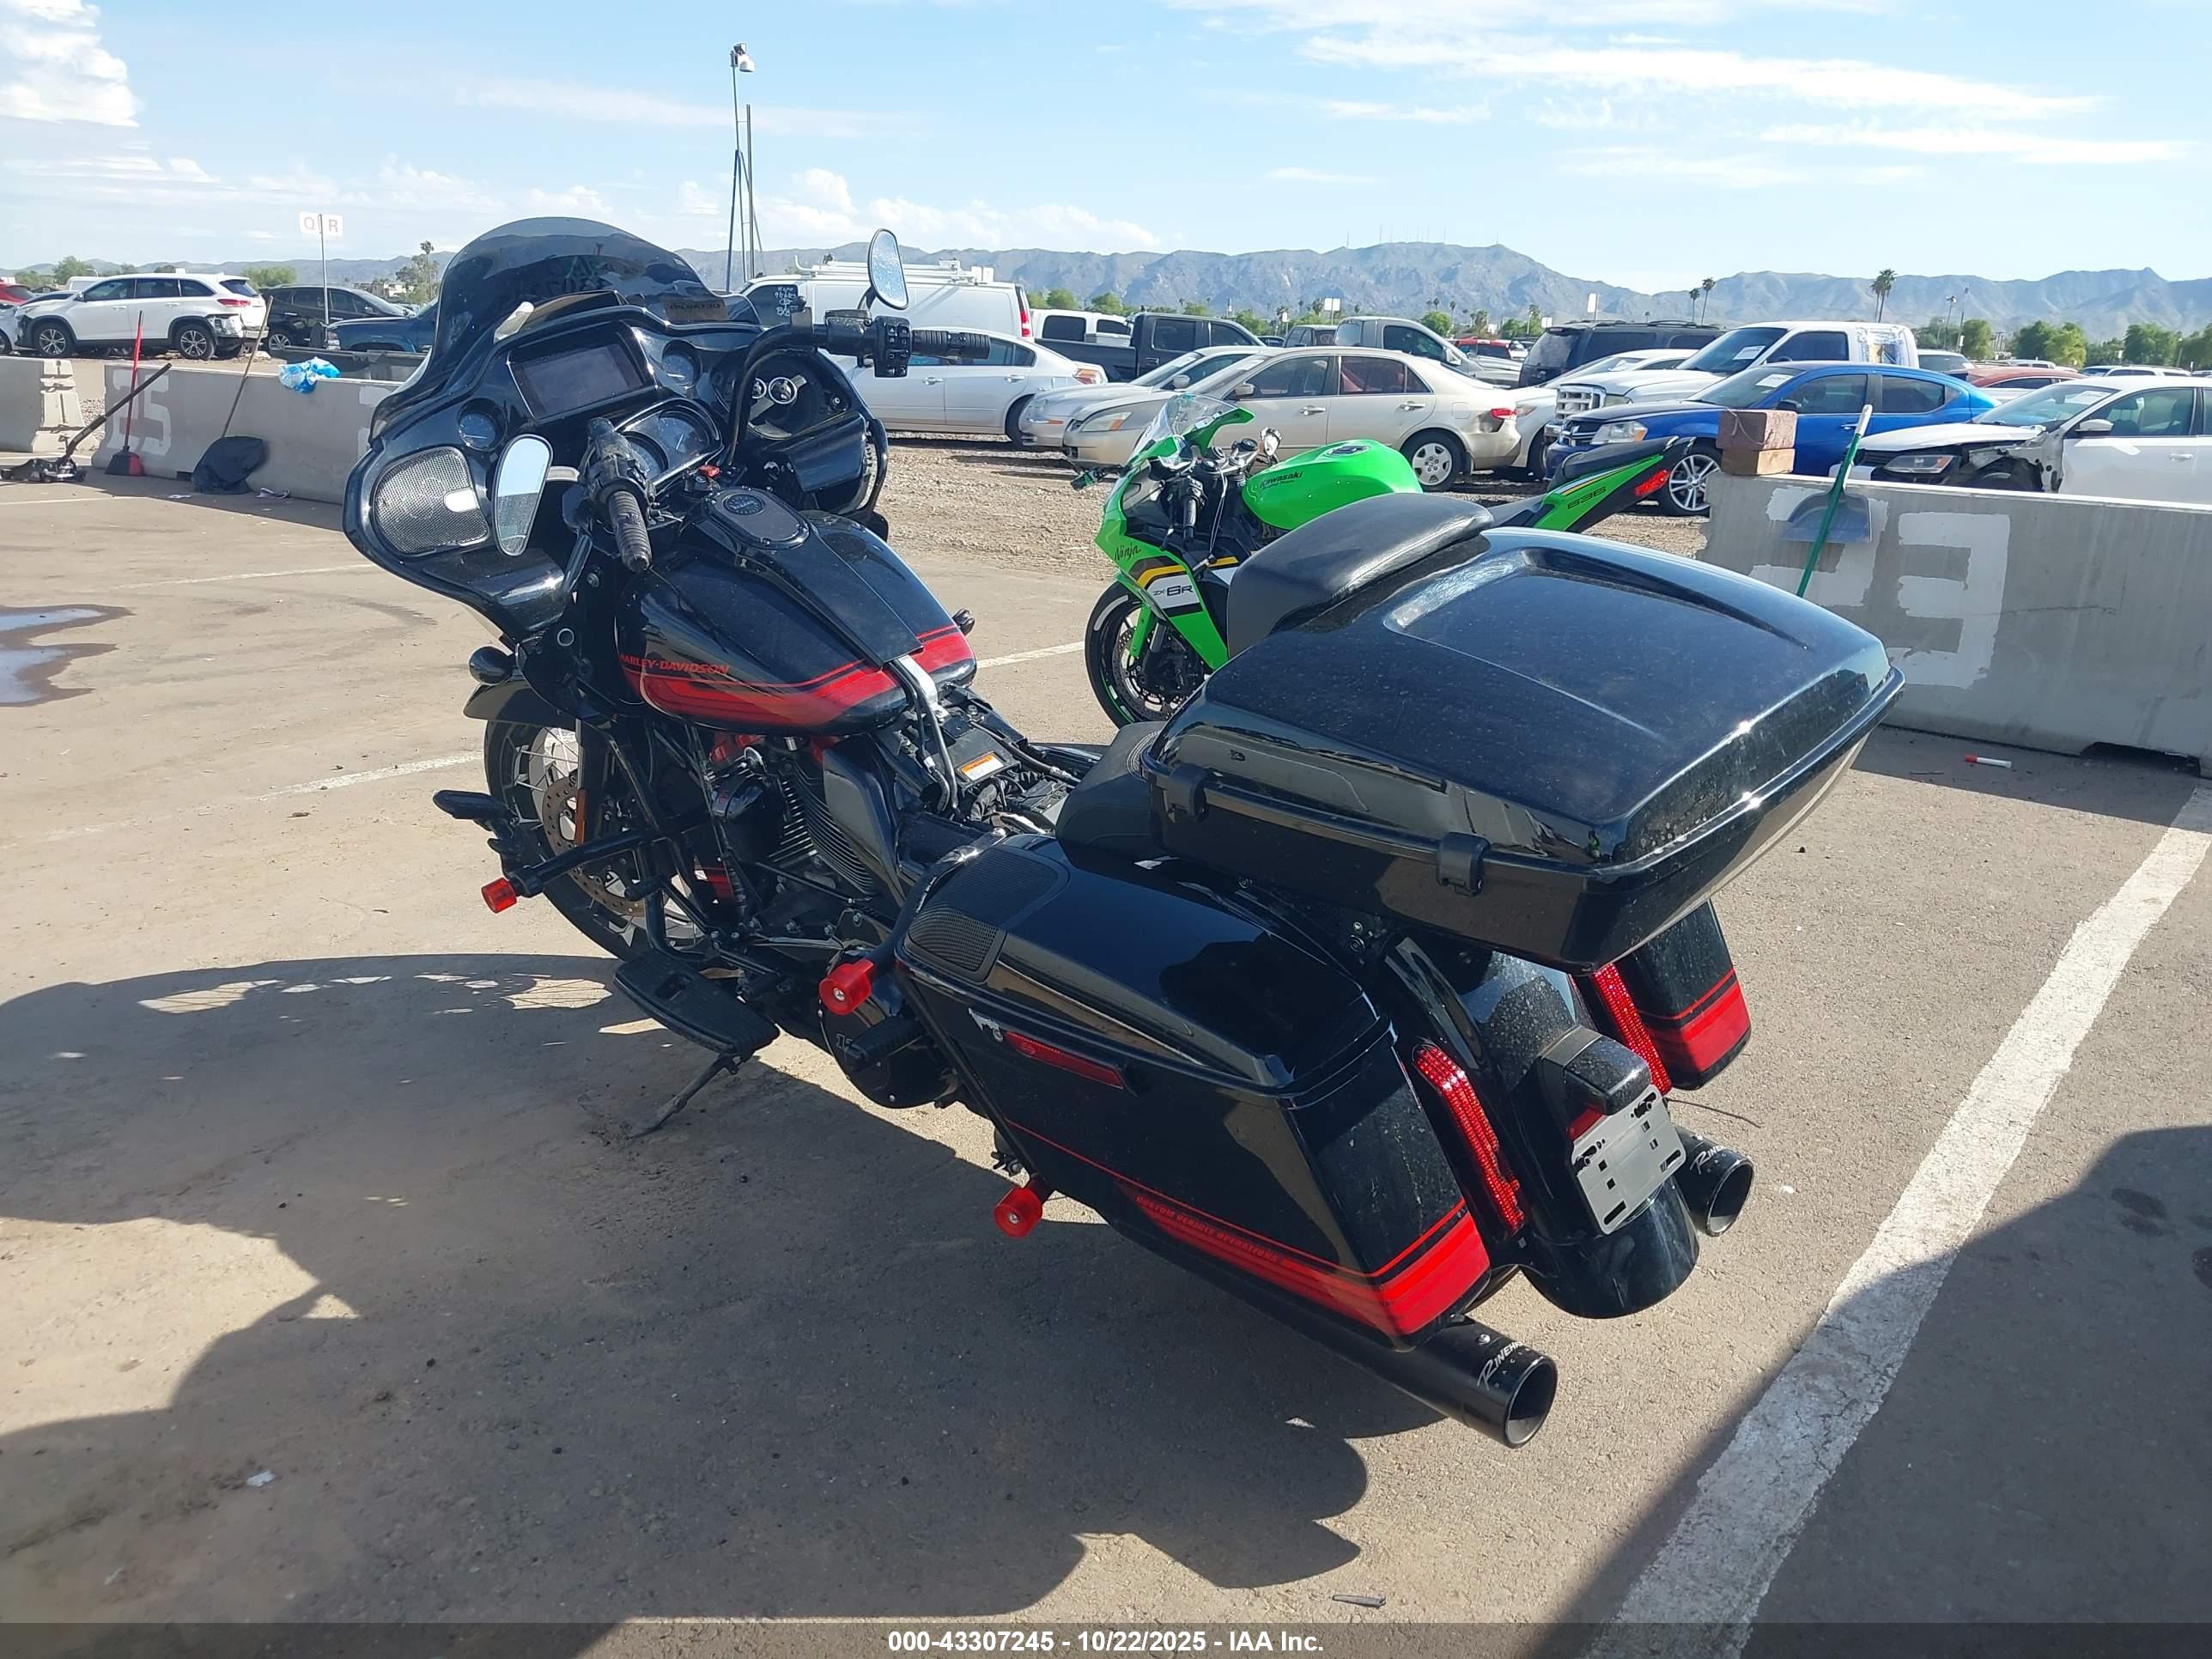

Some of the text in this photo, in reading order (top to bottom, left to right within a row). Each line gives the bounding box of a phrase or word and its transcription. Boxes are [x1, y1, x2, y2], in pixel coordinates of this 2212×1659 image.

[304, 216, 337, 233] Q R
[1261, 471, 1304, 488] Kawasaki
[1567, 486, 1606, 509] 636
[1115, 543, 1141, 562] Ninja
[1136, 1194, 1176, 1218] CUSTOM
[1216, 1231, 1279, 1263] OPERATIONS
